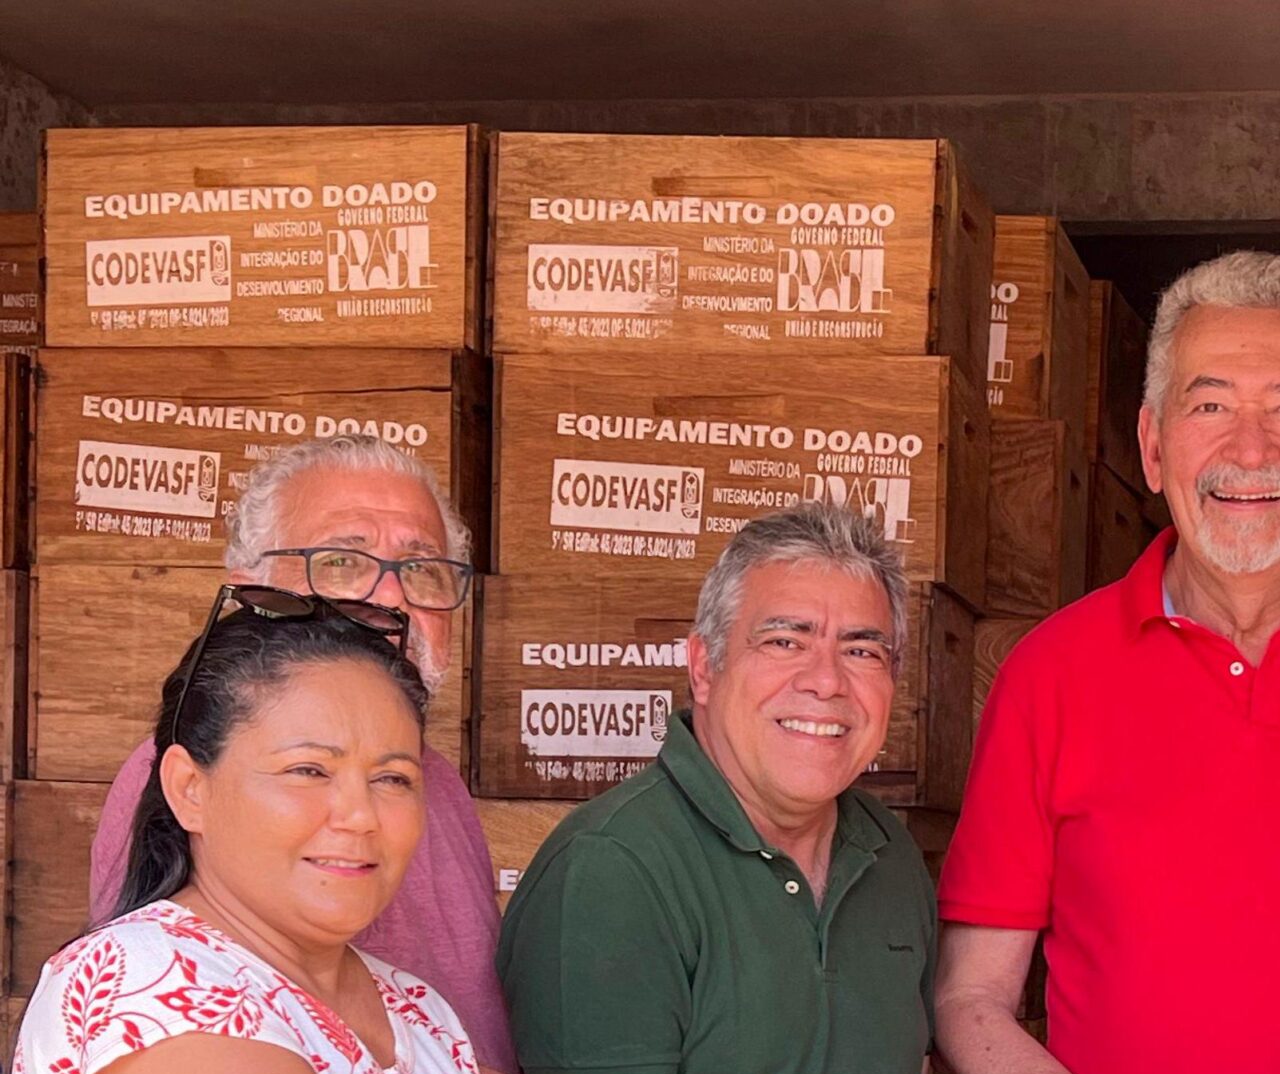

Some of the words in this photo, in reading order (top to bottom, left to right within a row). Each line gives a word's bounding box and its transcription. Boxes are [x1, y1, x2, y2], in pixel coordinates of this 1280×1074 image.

[85, 185, 313, 220] EQUIPAMENTO
[322, 180, 437, 208] DOADO
[528, 197, 766, 226] EQUIPAMENTO
[776, 202, 895, 227] DOADO
[309, 221, 323, 236] DA
[337, 208, 383, 226] GOVERNO
[386, 206, 428, 223] FEDERAL
[791, 227, 838, 245] GOVERNO
[840, 227, 884, 246] FEDERAL
[91, 249, 207, 287] CODEVASF
[301, 251, 309, 265] E
[310, 250, 323, 265] DO
[532, 256, 653, 293] CODEVASF
[751, 267, 758, 282] E
[760, 268, 774, 283] DO
[237, 280, 324, 297] DESENVOLVIMENTO
[82, 395, 307, 436] EQUIPAMENTO
[556, 412, 794, 450] EQUIPAMENTO
[803, 428, 923, 458] DOADO
[81, 453, 196, 495] CODEVASF
[786, 462, 801, 479] DA
[817, 454, 864, 474] GOVERNO
[867, 456, 911, 477] FEDERAL
[557, 472, 677, 512] CODEVASF
[713, 487, 774, 508] INTEGRAÇÃO
[776, 492, 783, 507] E
[526, 702, 646, 736] CODEVASF
